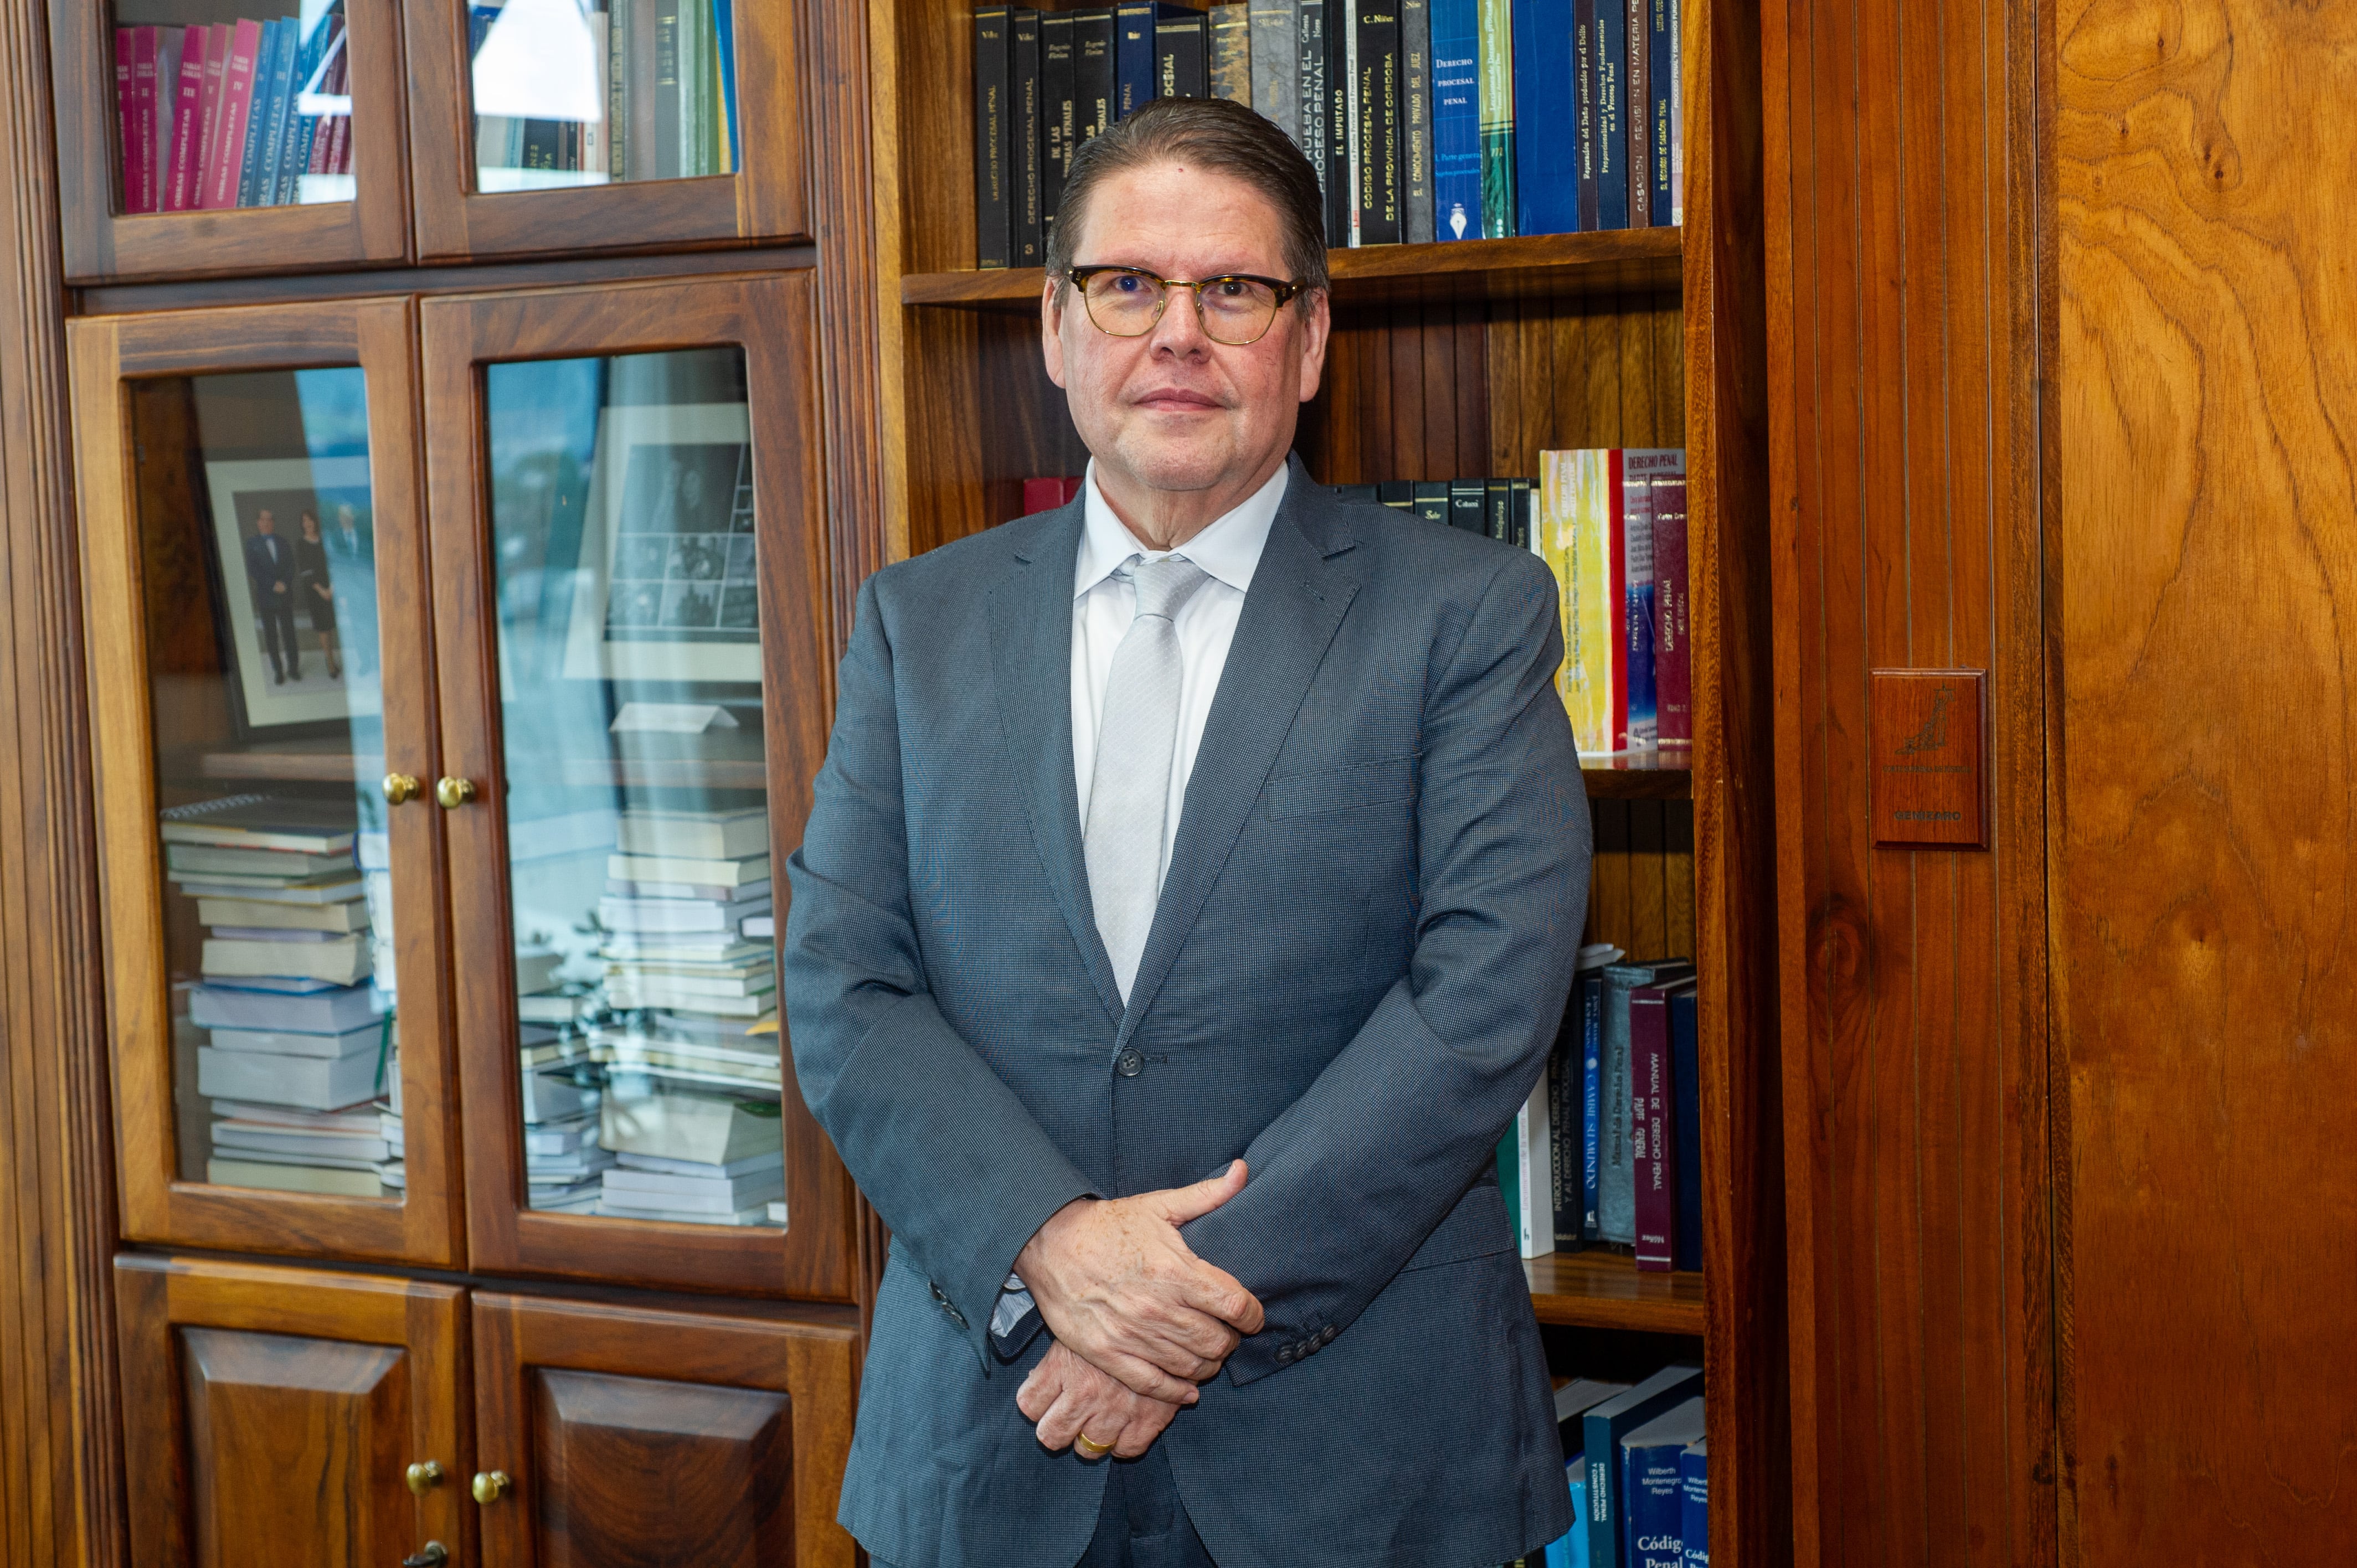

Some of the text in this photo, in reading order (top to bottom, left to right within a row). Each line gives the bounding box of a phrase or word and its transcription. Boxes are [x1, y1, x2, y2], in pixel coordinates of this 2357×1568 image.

[1631, 0, 1639, 12] PE
[1163, 54, 1175, 97] OCESAL
[1436, 59, 1473, 68] DERECHO
[1488, 65, 1494, 75] de
[1633, 70, 1640, 84] EN
[988, 85, 996, 114] PENAL
[1025, 78, 1033, 114] PENAL
[1123, 82, 1132, 110] PENAL
[1438, 78, 1474, 87] PROCESAL
[1580, 70, 1589, 104] producido
[1063, 100, 1072, 137] PENALES
[1302, 49, 1312, 160] RUEBA EN EL
[1444, 97, 1467, 106] PENAL
[1634, 89, 1642, 140] REVISIN
[244, 98, 261, 173] COMPLETAS
[264, 96, 282, 172] COMPLETAS
[1085, 125, 1095, 141] LAS
[1313, 56, 1326, 193] PROCESO PENAL
[1334, 89, 1344, 156] EL IMPUTADO
[1363, 66, 1373, 209] CODIGO PROCESAL PENAL
[1385, 53, 1394, 221] DE LA PROVINCIA DE CORDOBA
[1411, 53, 1423, 197] EL CONOCIMIENTO PRIVADO DEL JUEZ
[1609, 123, 1615, 132] en
[174, 109, 191, 208] OBRAS COMPLETAS
[194, 106, 211, 206] OBRAS COMPLETAS
[217, 102, 238, 203] OBRAS COMPLETAS
[1051, 126, 1061, 159] DE LAS
[1601, 116, 1609, 173] Proporcionalidad
[1636, 155, 1645, 212] CASACION
[1629, 454, 1678, 470] DERECHO PENAL
[1663, 580, 1674, 652] DERECHO PENAL
[1614, 1045, 1624, 1073] Penal
[1613, 1075, 1623, 1115] Derecho
[1553, 1129, 1560, 1141] AL
[1587, 1122, 1596, 1137] SU
[1634, 1097, 1645, 1159] PARTE GENERAL
[1651, 1053, 1662, 1191] MANUAL DE DERECHO PENAL
[1520, 1150, 1526, 1159] de
[1586, 1143, 1596, 1189] MUNDO
[1553, 1143, 1562, 1211] INTRODUCCION
[1565, 1182, 1572, 1194] AL
[1641, 1478, 1682, 1486] Montenegro
[1648, 1467, 1676, 1475] Wilberth
[1651, 1487, 1673, 1496] Reyes
[1645, 1556, 1683, 1568] Penal
